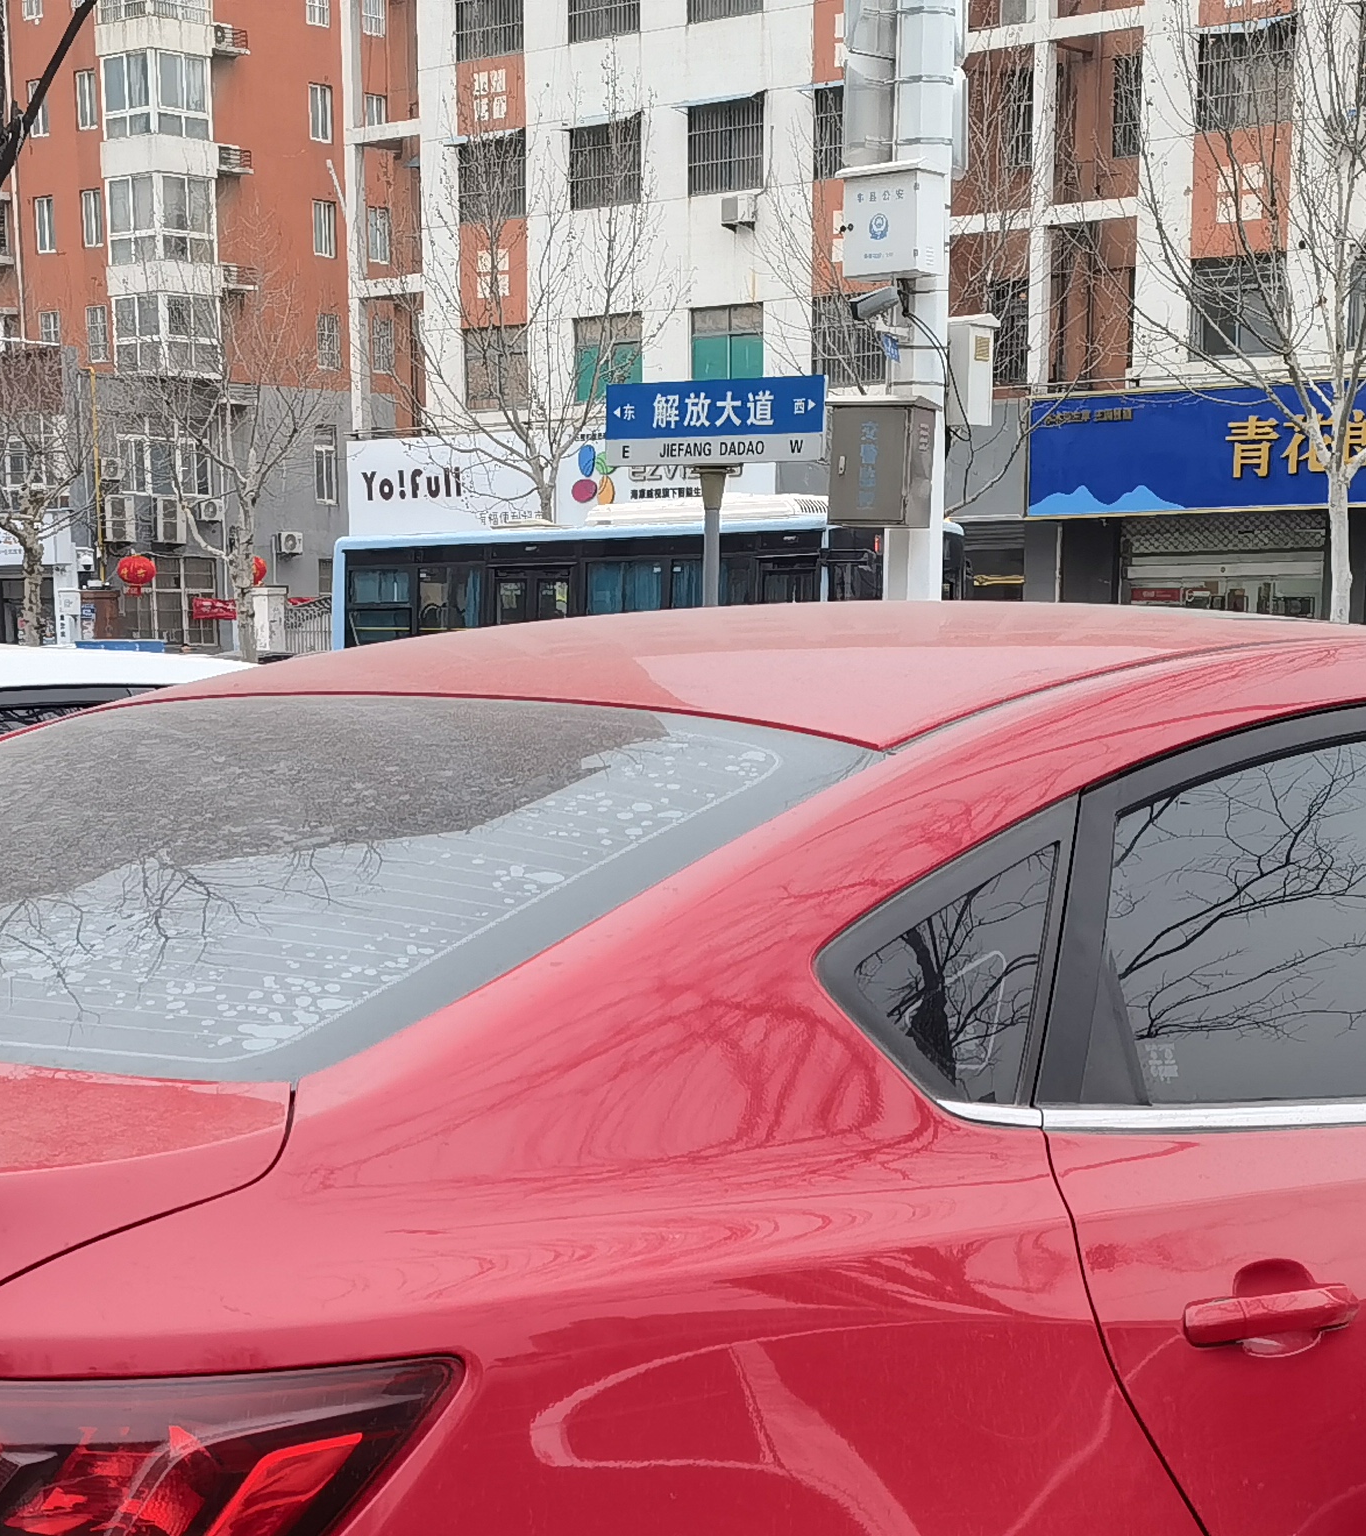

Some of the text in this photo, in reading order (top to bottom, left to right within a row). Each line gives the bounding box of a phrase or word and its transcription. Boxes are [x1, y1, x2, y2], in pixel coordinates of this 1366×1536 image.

[622, 389, 806, 429] 东 解放大道 西
[621, 439, 804, 459] E JIEFANG DADAO W
[361, 466, 462, 501] Yo!full
